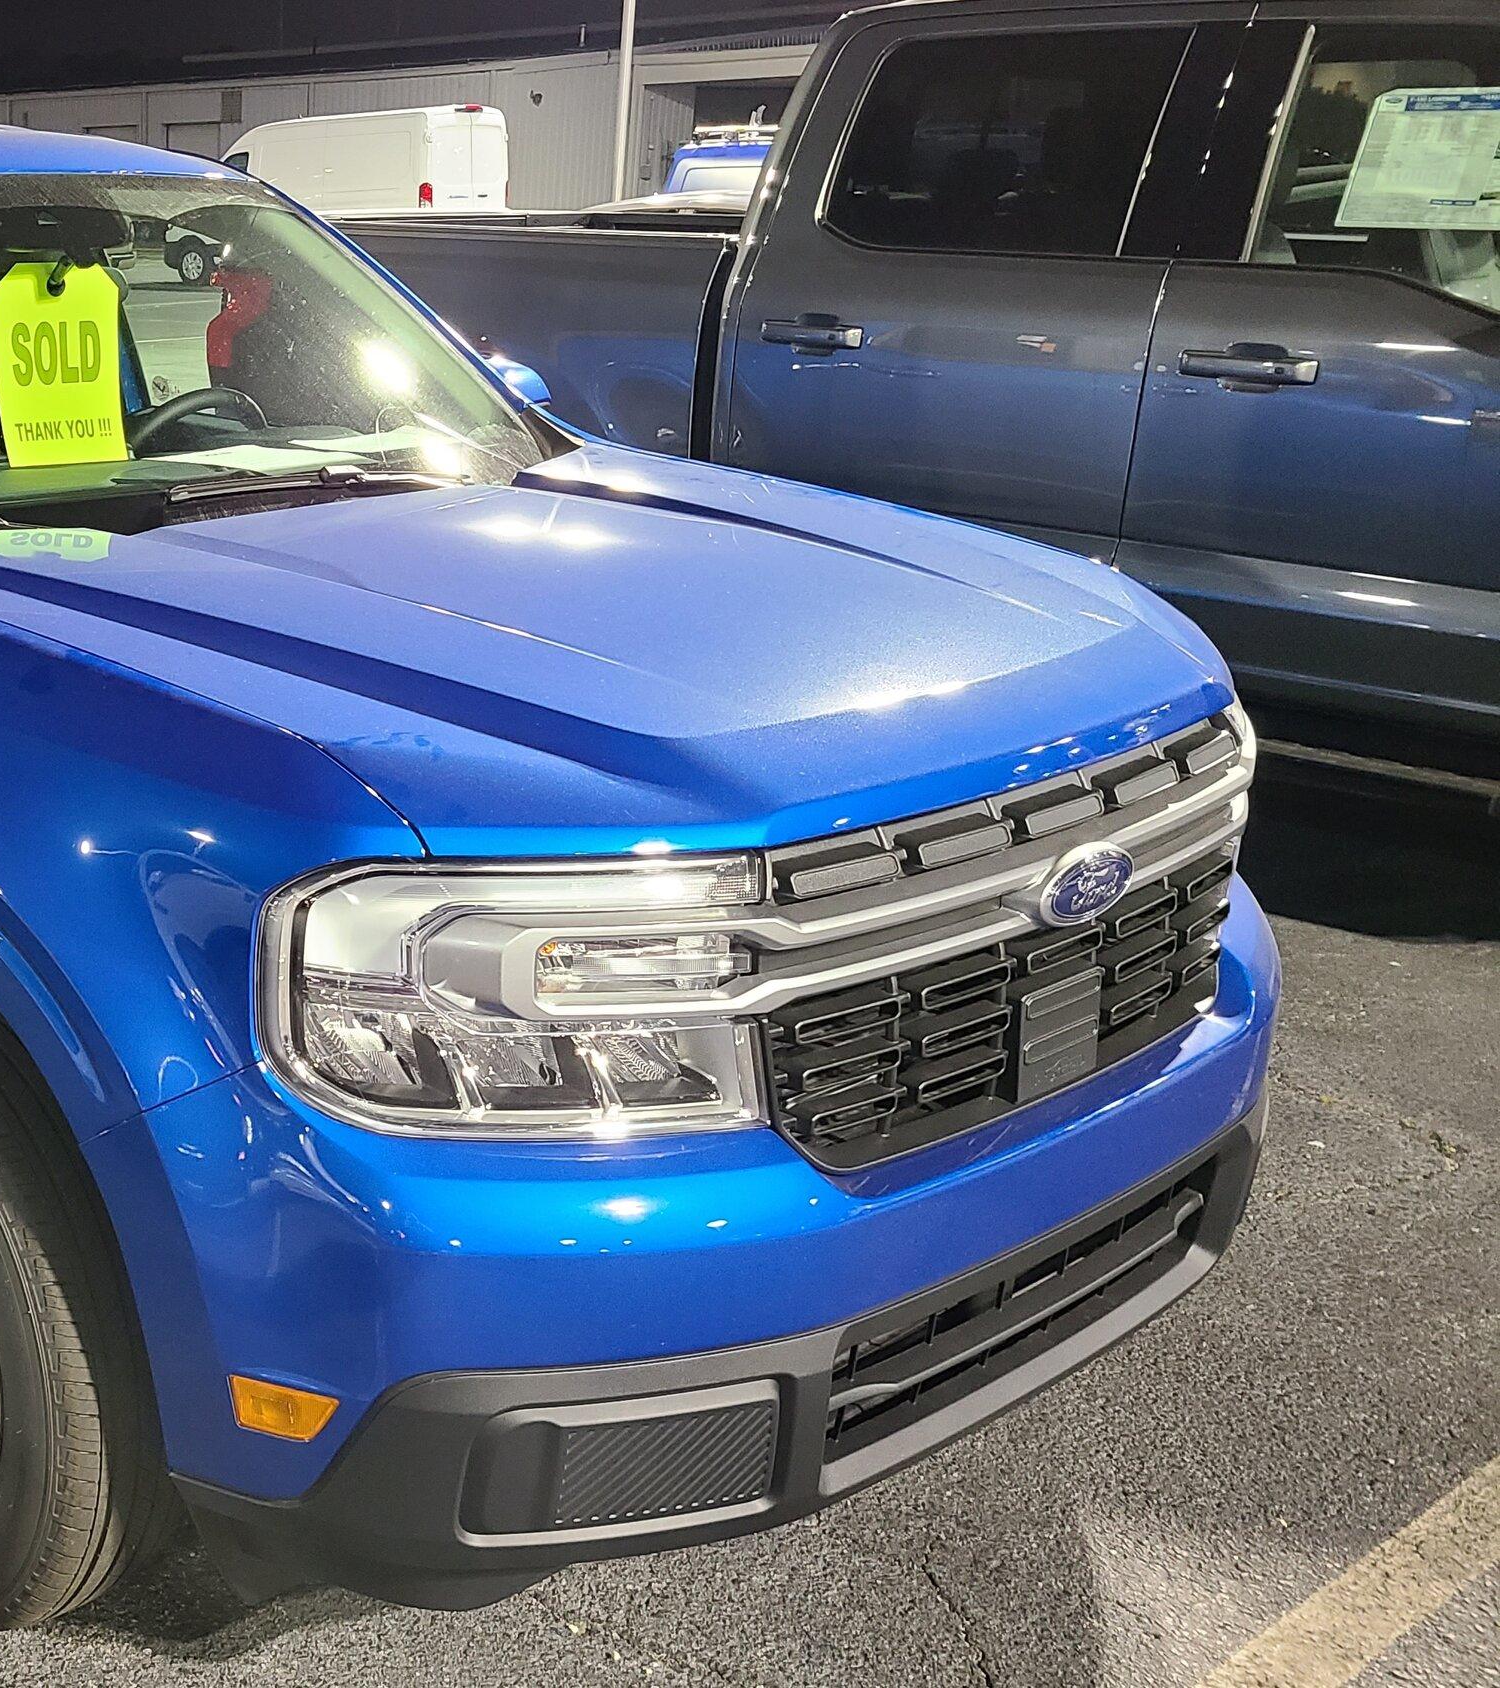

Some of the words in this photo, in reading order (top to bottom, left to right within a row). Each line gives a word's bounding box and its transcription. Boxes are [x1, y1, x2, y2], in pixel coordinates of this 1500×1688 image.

[11, 320, 100, 386] SOLD
[14, 420, 64, 442] THANK
[66, 418, 95, 439] YOU
[98, 417, 112, 437] !!!
[1066, 867, 1120, 912] Ford
